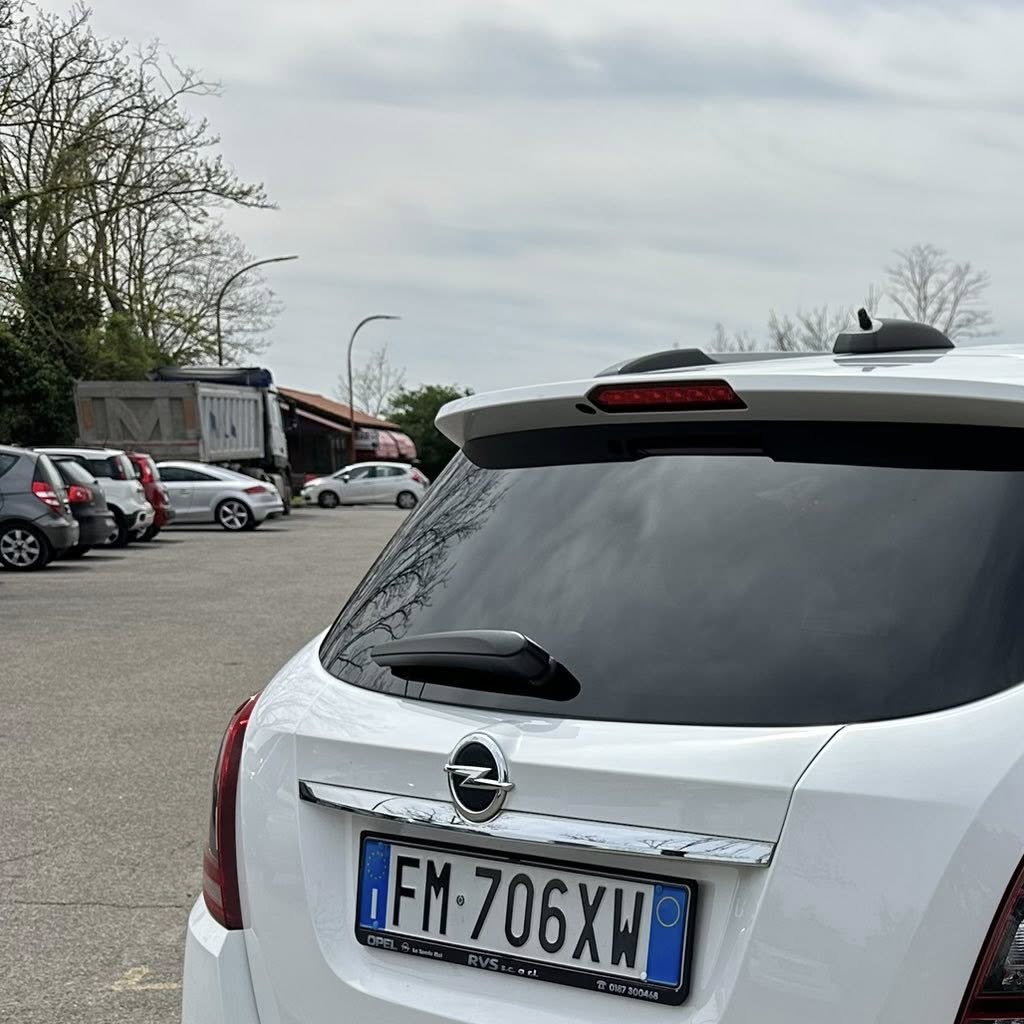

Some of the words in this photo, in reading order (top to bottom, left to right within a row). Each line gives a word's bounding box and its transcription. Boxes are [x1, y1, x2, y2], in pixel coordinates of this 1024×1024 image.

[392, 855, 451, 935] FM
[470, 866, 645, 968] 706XW
[367, 934, 398, 950] OPEL
[467, 954, 499, 970] RVS
